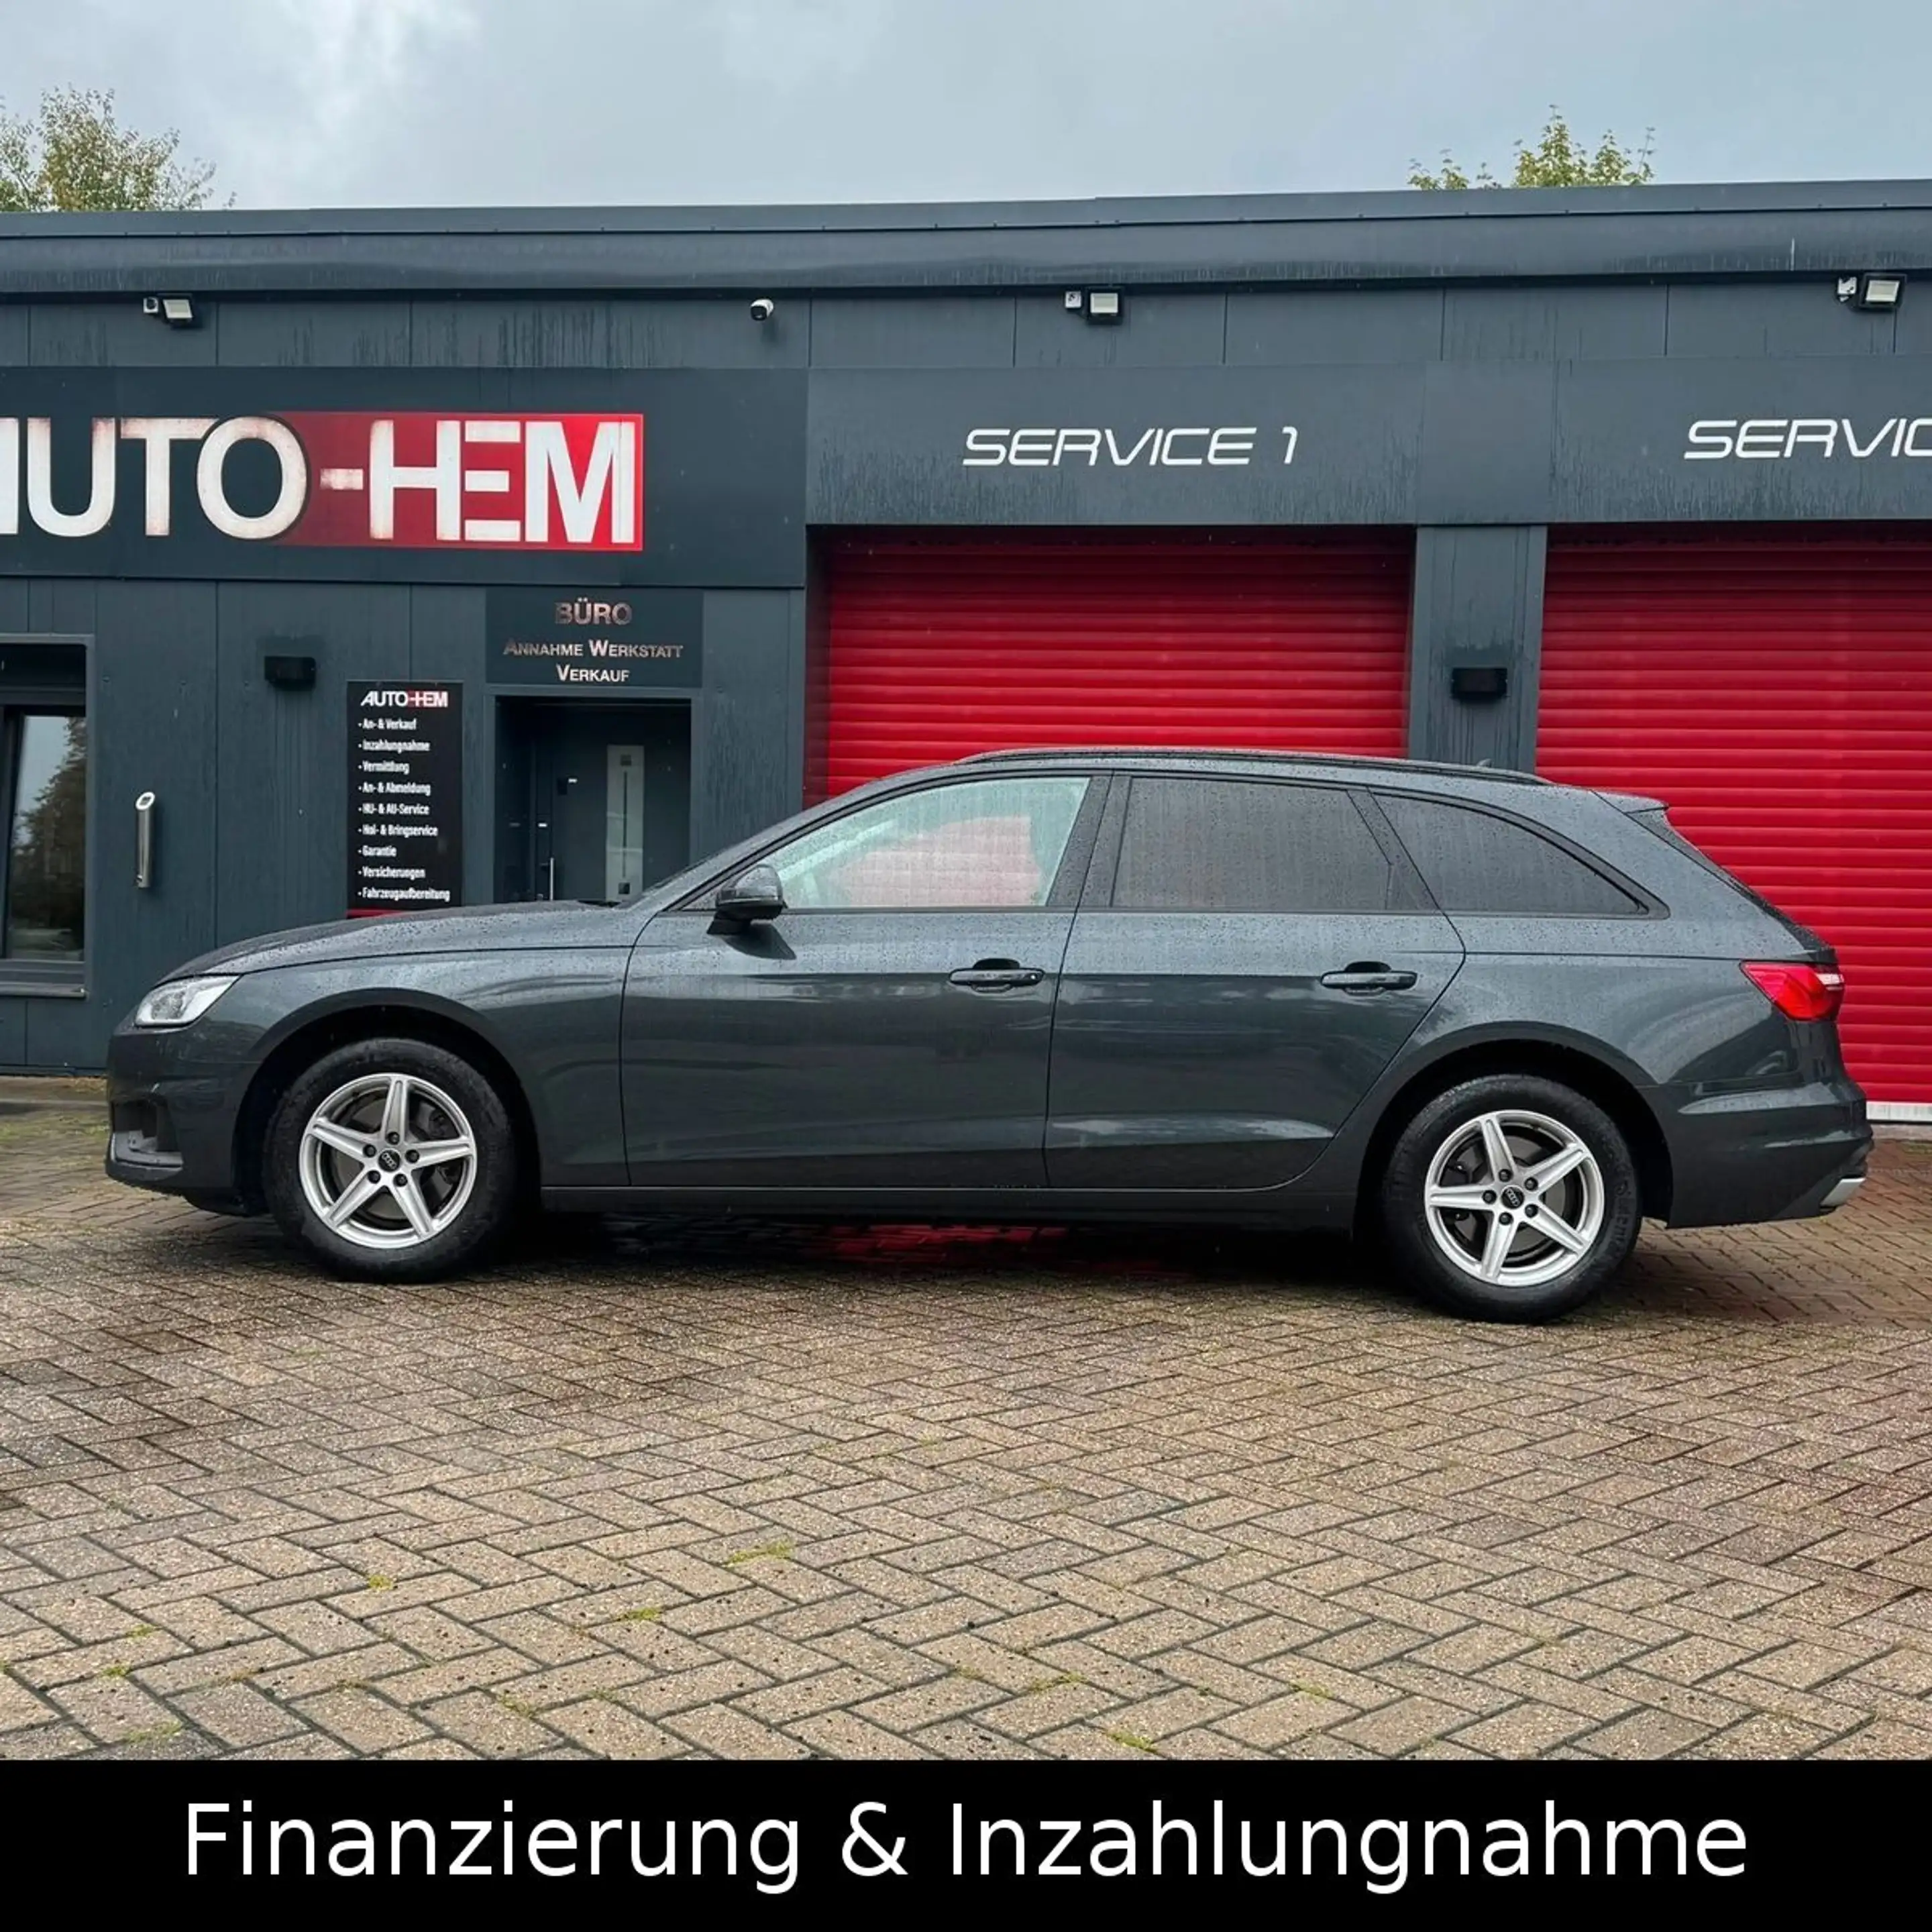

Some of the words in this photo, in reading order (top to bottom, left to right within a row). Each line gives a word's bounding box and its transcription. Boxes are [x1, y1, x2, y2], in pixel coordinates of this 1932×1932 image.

[963, 427, 1257, 466] SERVICE
[1282, 426, 1298, 464] 1
[0, 416, 635, 544] UTO-HEM
[555, 596, 632, 625] BÜRO
[385, 718, 417, 731] Verkauf
[362, 845, 397, 857] Garantie
